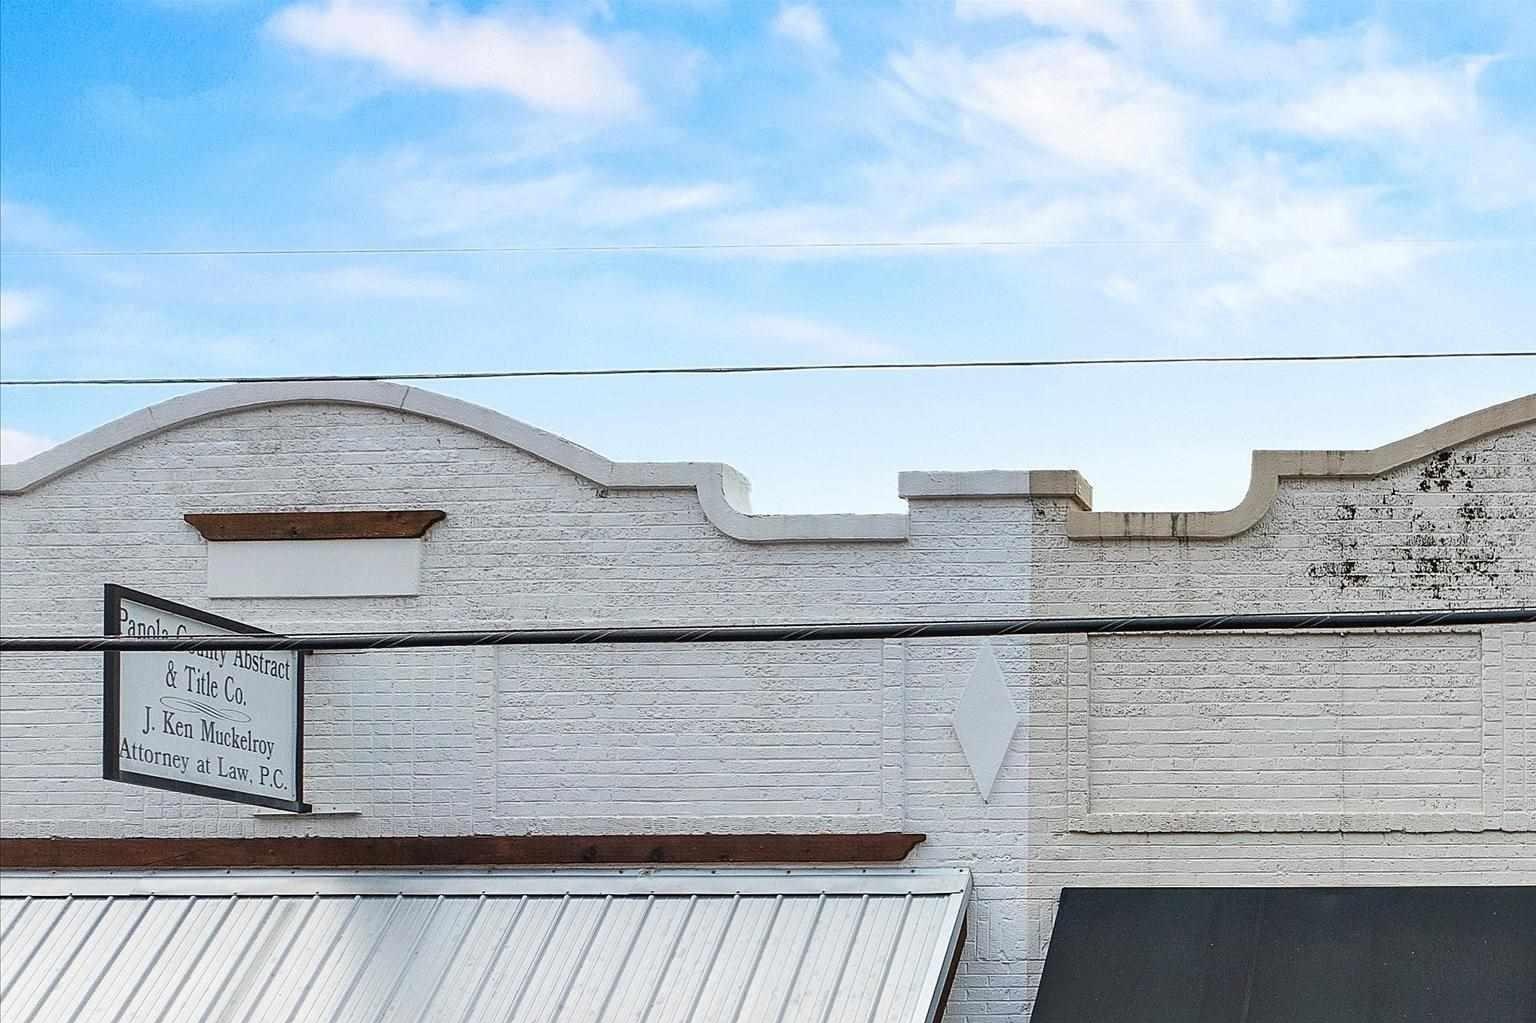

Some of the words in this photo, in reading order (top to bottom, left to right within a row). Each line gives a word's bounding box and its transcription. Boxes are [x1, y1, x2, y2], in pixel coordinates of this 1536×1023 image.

[166, 660, 177, 688] &
[184, 665, 218, 698] Title
[224, 676, 247, 706] Co.
[233, 648, 291, 681] Abstract
[142, 706, 155, 734] J.
[163, 710, 193, 739] Ken
[201, 719, 275, 760] Muckelroy
[119, 737, 189, 773] Attorney
[196, 757, 210, 774] at
[258, 765, 288, 790] P.C.
